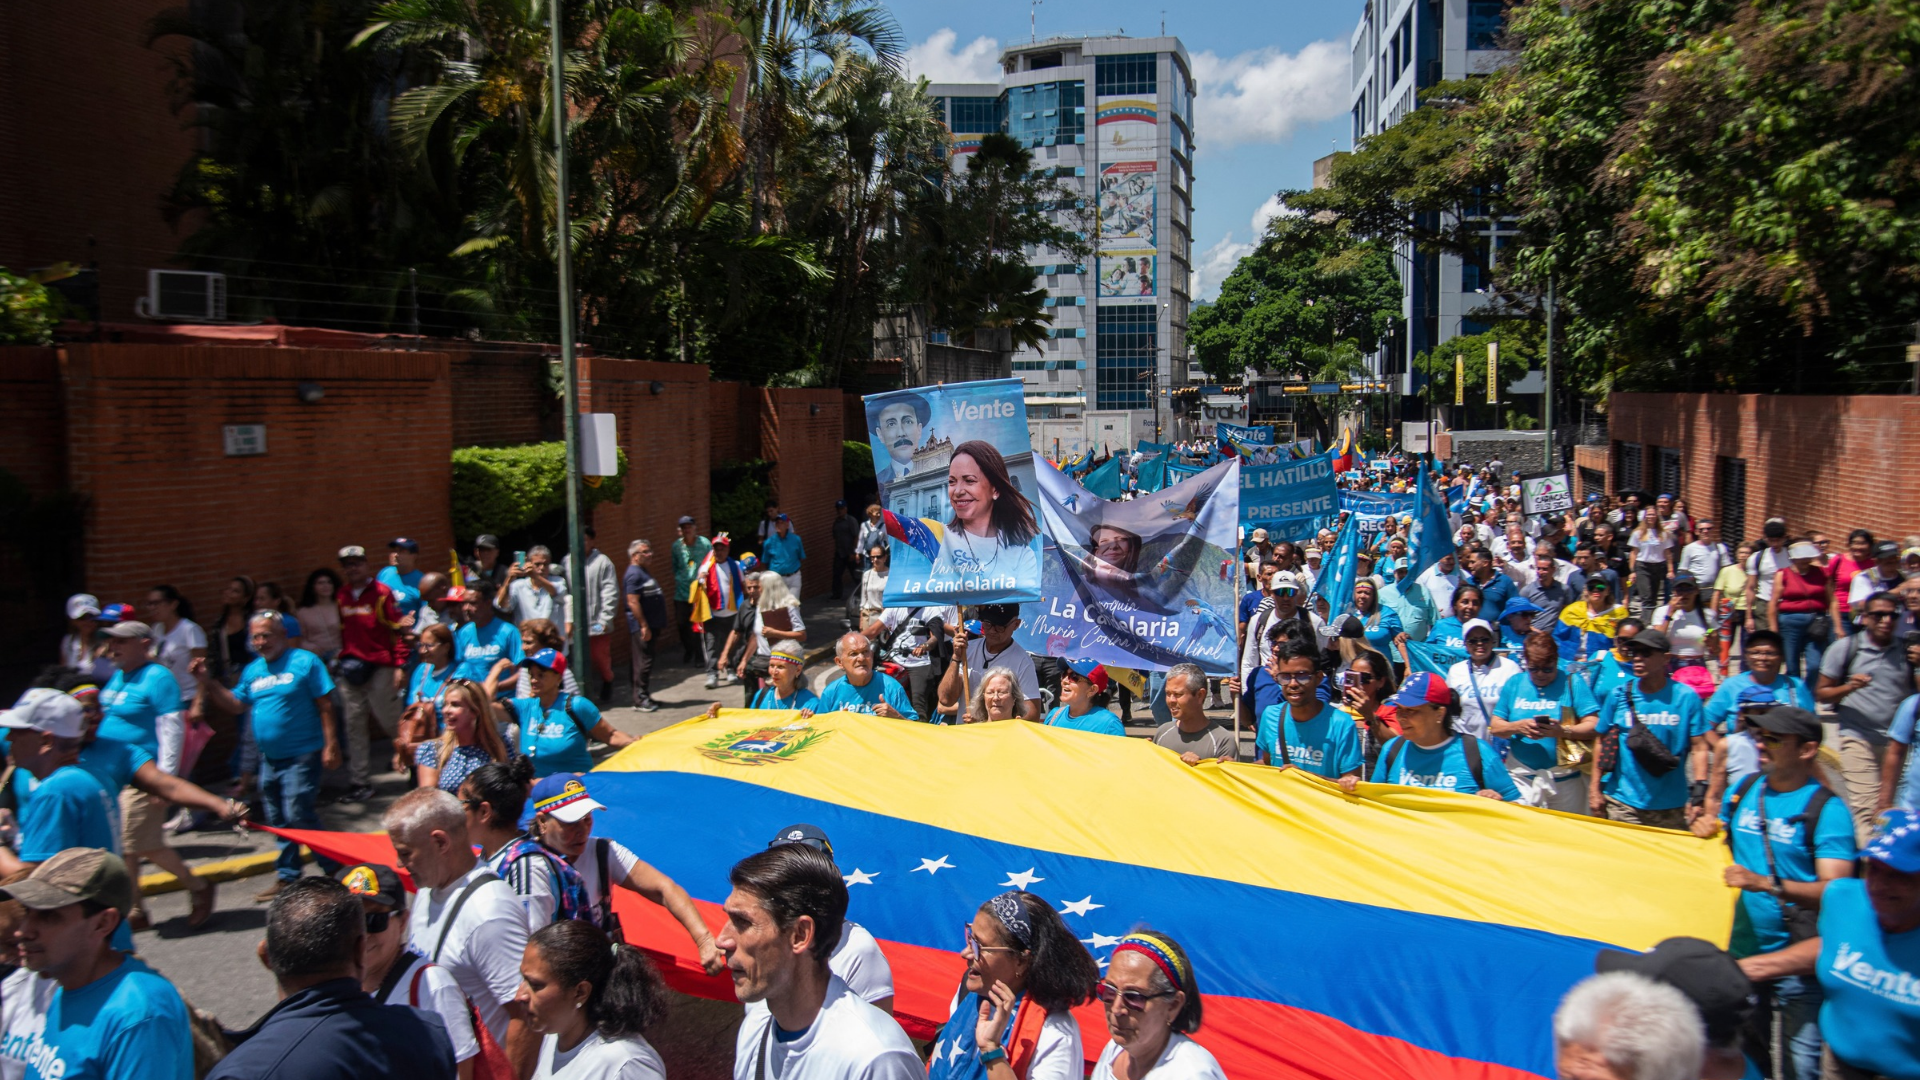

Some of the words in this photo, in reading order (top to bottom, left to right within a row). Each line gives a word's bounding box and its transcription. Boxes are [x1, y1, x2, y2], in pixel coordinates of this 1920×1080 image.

[952, 400, 1015, 421] Vente
[1203, 405, 1248, 419] traki
[1143, 419, 1160, 428] Rotay
[1226, 426, 1267, 441] Vente
[1260, 461, 1328, 487] HATILLO
[1248, 495, 1332, 519] PRESENTE
[903, 580, 921, 593] La
[925, 574, 1016, 593] Candelaria
[1050, 597, 1076, 619] La
[1514, 696, 1557, 711] Vente
[1399, 766, 1457, 788] Vente
